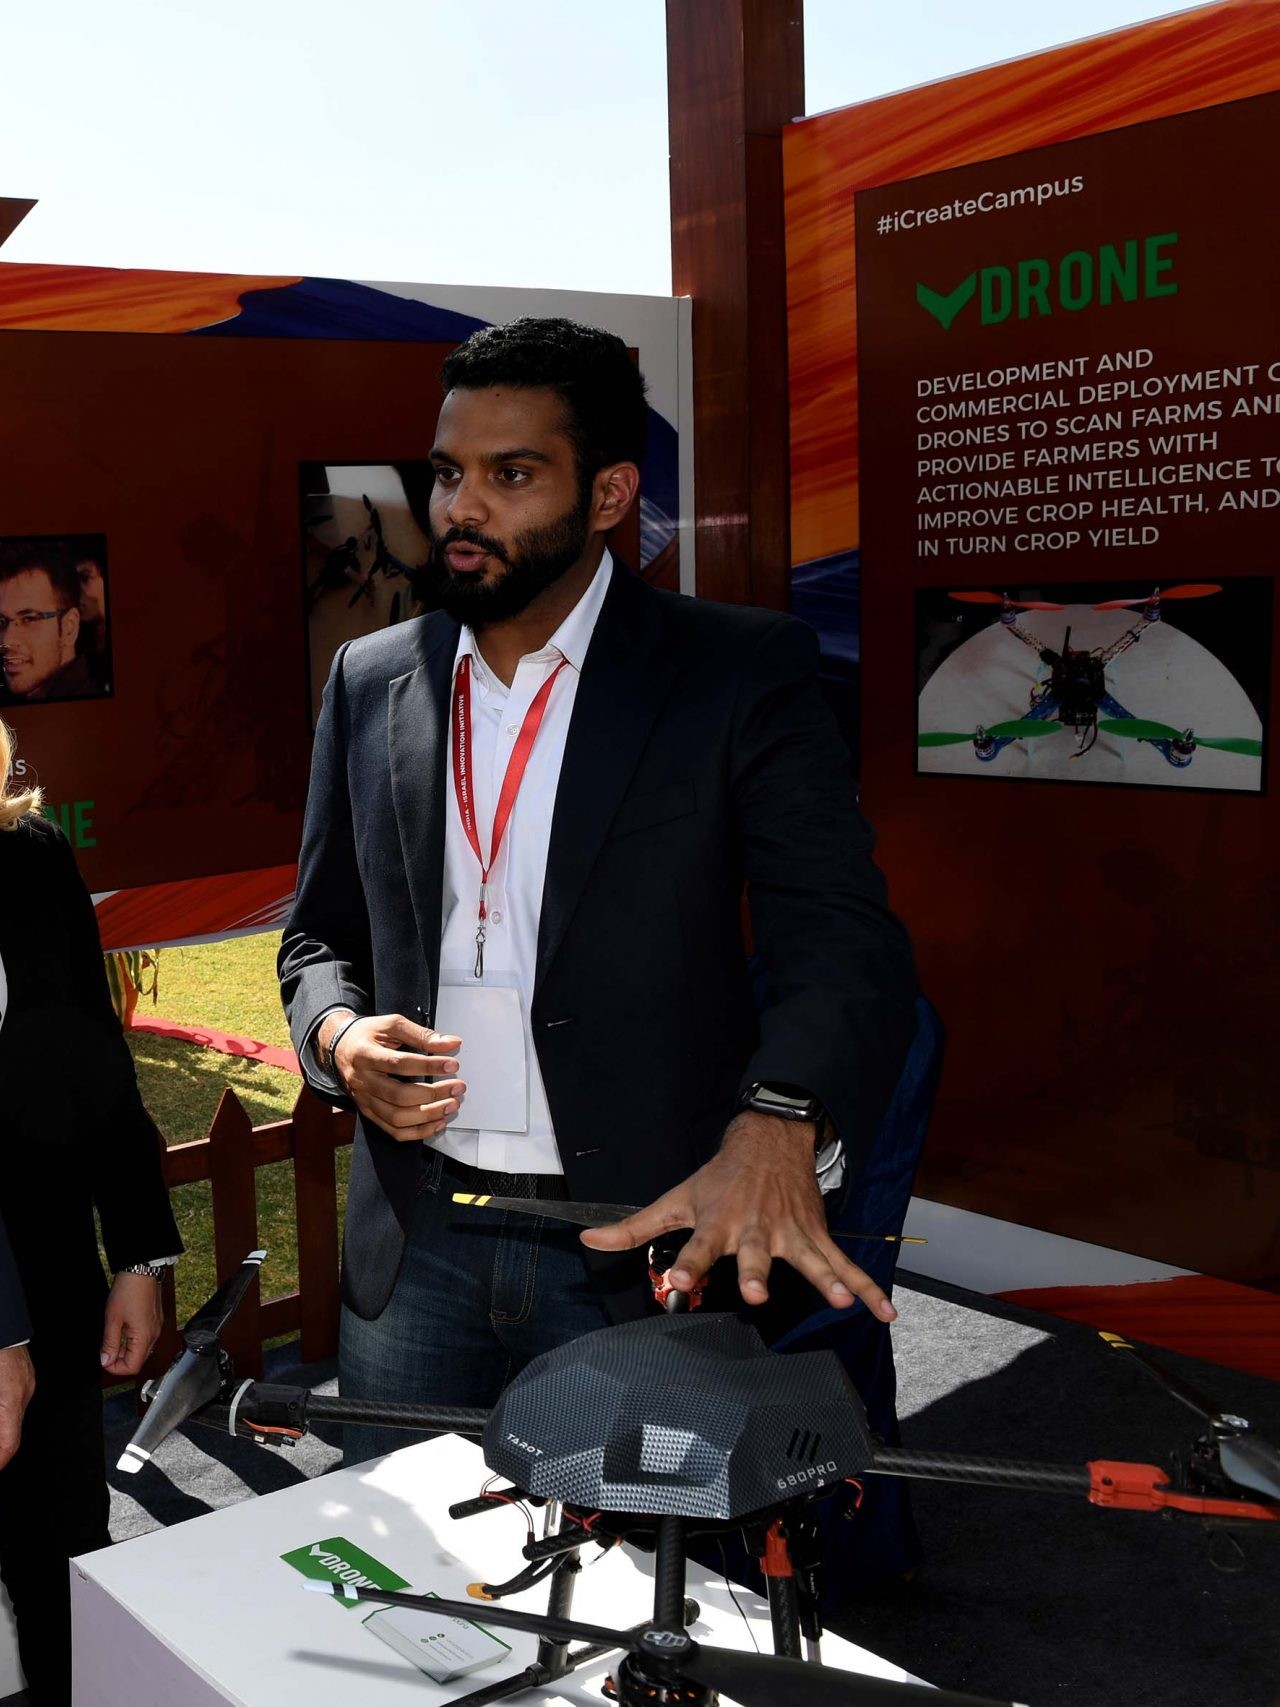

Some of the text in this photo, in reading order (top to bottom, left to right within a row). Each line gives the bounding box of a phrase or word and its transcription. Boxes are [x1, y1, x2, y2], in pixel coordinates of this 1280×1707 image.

[877, 176, 1084, 235] #iCreateCampus
[916, 389, 1070, 423] COMMERCIAL
[1079, 365, 1260, 405] DEPLOYMENT
[917, 349, 1154, 397] DEVELOPMENT AND
[918, 393, 1280, 451] DRONES TO SCAN FARMS AN
[918, 431, 1218, 477] PROVIDE FARMERS WITH
[917, 475, 1060, 504] ACTIONABLE
[1069, 459, 1252, 492] INTELLIGENCE
[918, 488, 1280, 530] IMPROVE CROP HEALTH, AND
[918, 526, 1160, 557] IN TURN CROP YIELD
[458, 693, 466, 731] INITIATIVE
[460, 776, 468, 803] ISRAEL
[507, 1433, 544, 1456] TAROT
